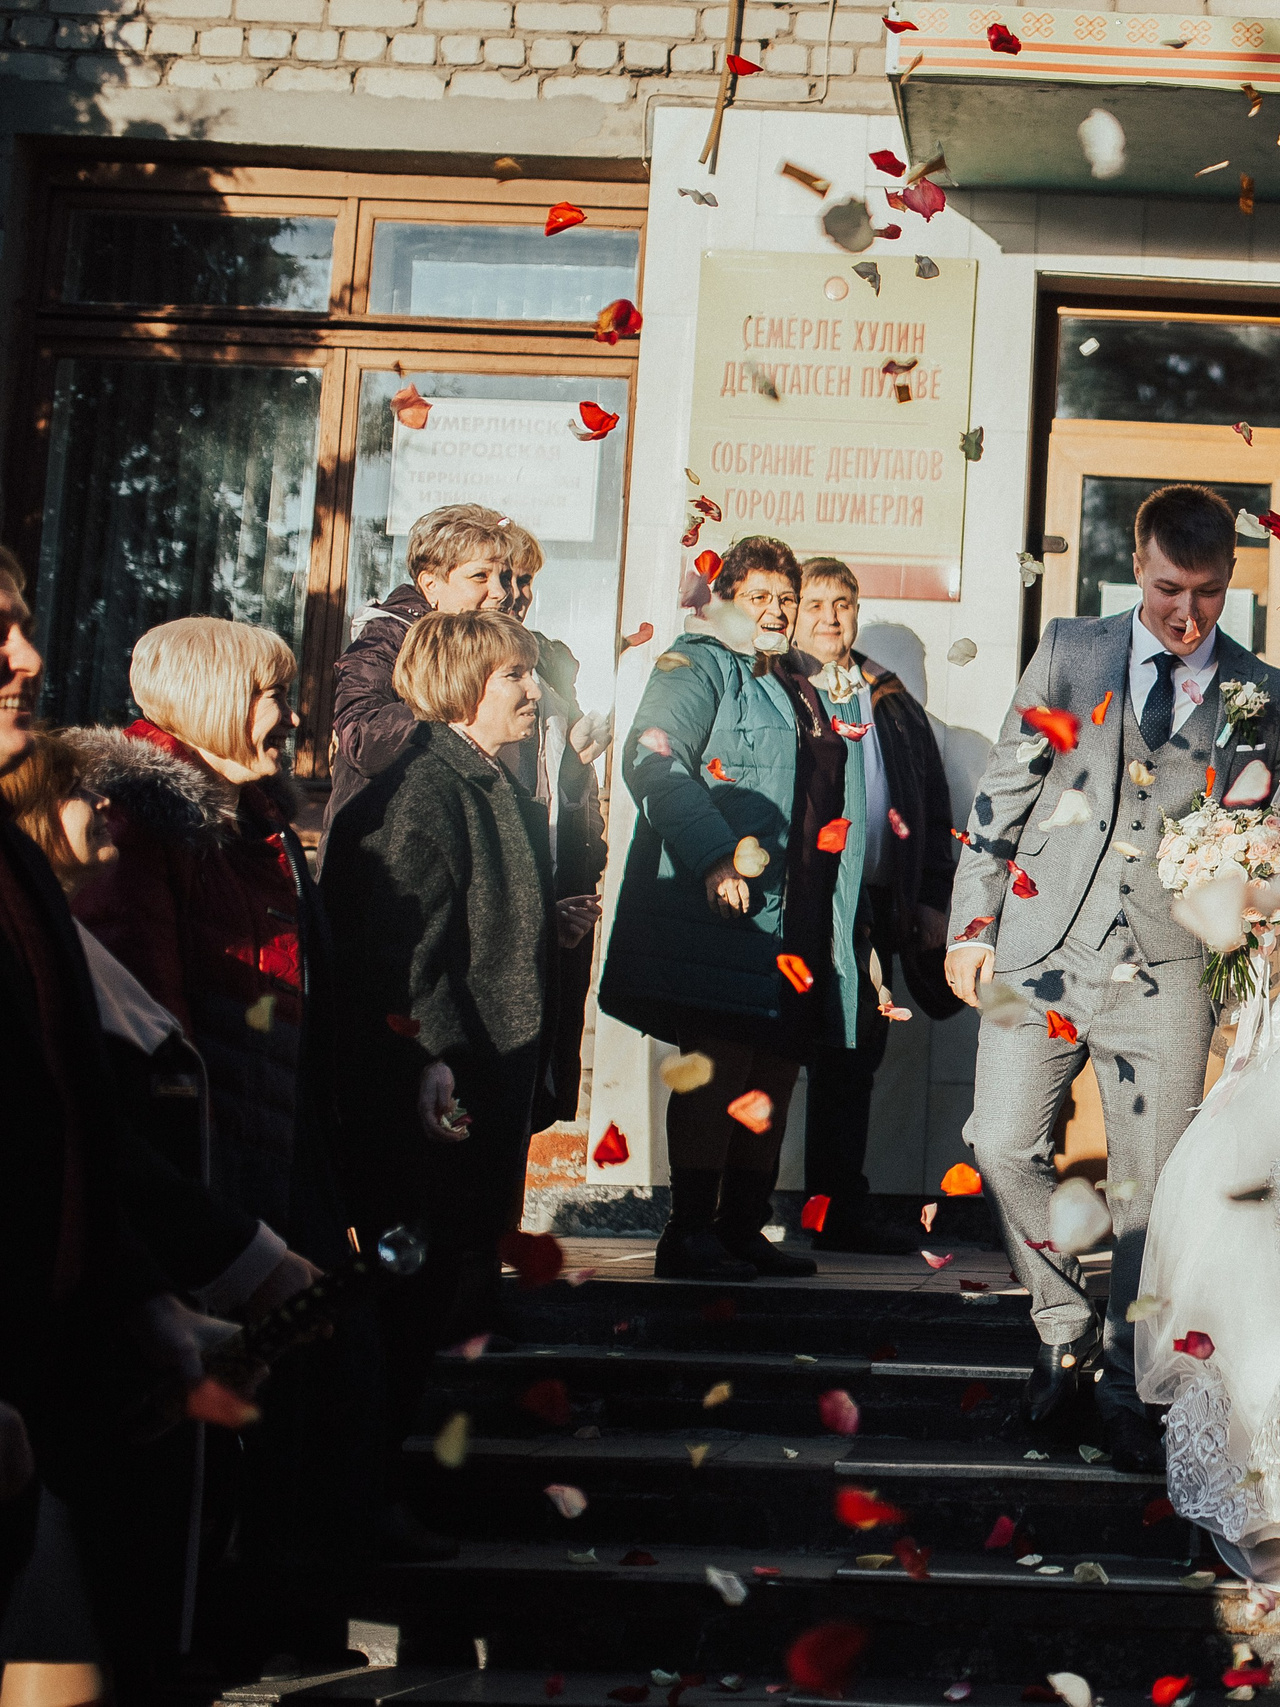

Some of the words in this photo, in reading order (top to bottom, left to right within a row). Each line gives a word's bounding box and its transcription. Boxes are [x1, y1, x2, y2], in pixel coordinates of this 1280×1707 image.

[853, 320, 926, 353] ХУЛИН
[720, 361, 851, 397] ДЕПУТАТСЕН
[711, 441, 816, 478] СОБРАНИЕ
[825, 446, 944, 483] ДЕПУТАТОВ
[724, 487, 805, 526] ГОРОДА
[815, 491, 924, 527] ШУМЕРЛЯ
